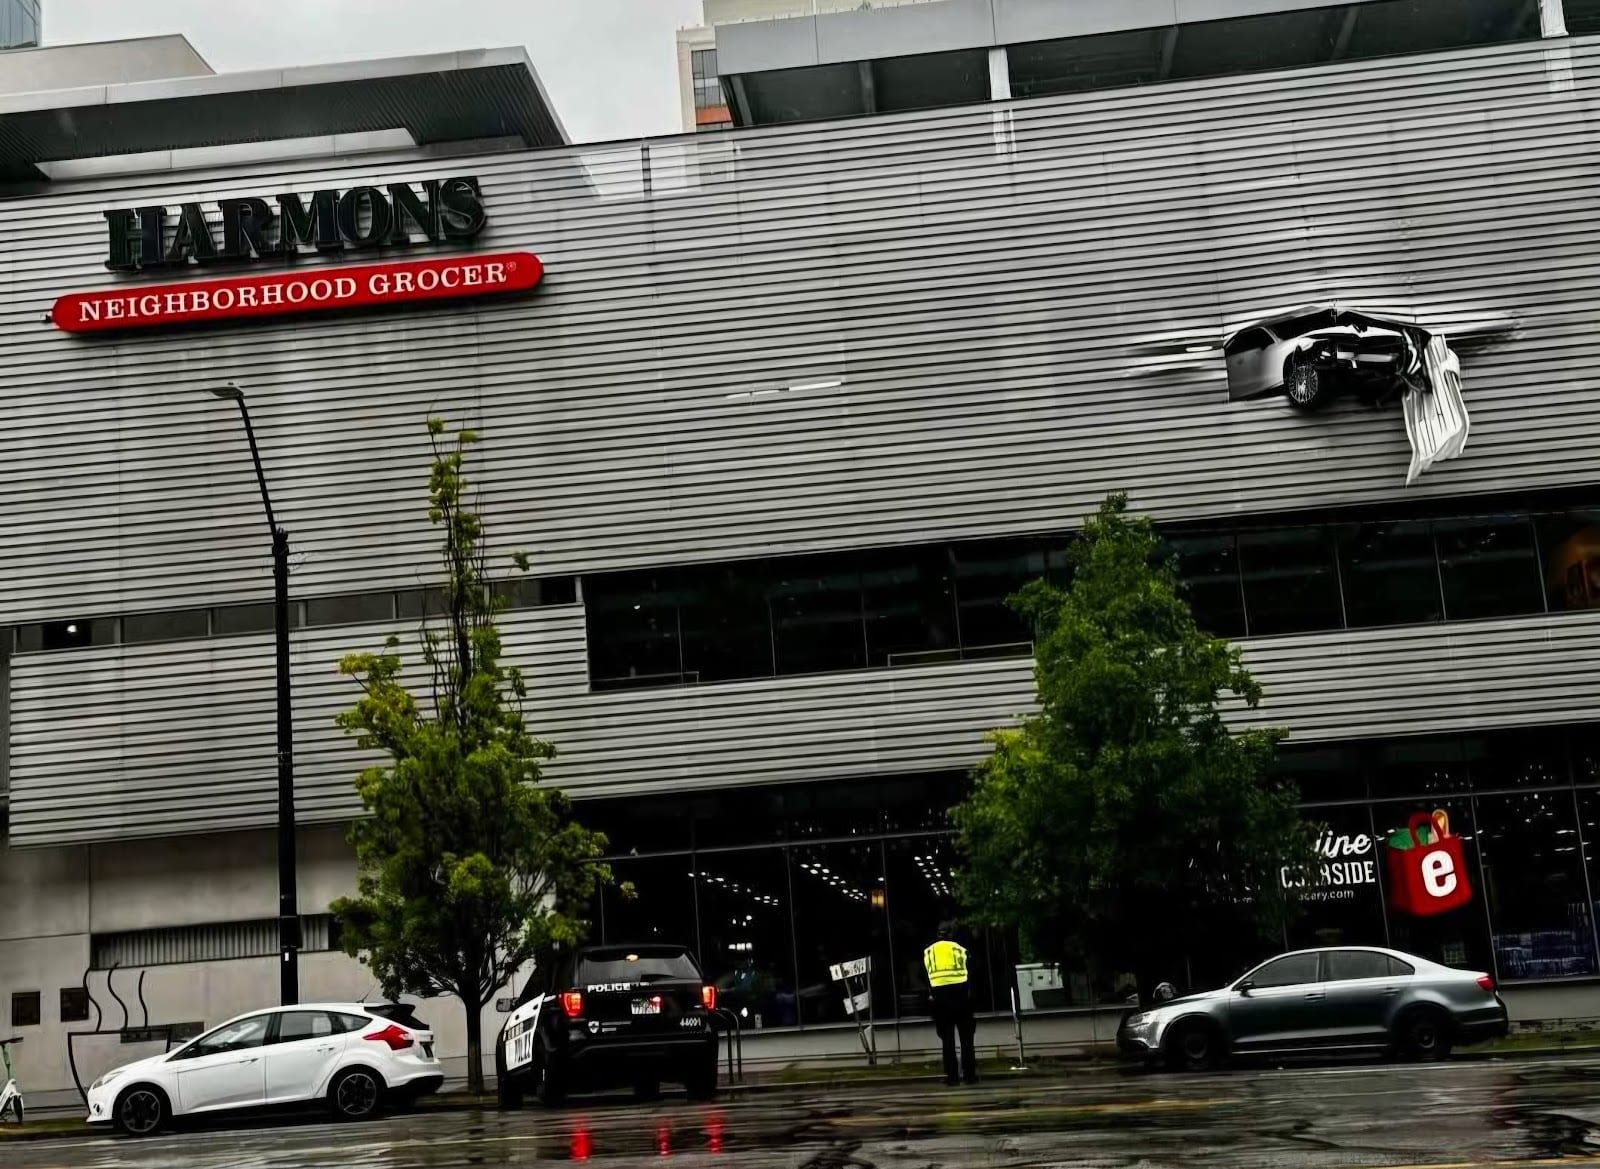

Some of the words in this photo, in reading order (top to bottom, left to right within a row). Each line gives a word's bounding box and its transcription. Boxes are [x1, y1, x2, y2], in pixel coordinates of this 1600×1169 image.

[103, 175, 488, 273] HARMONS
[79, 275, 357, 322] NEIGHBORHOOD
[1280, 861, 1376, 889] CSIDE
[587, 983, 631, 993] POLICE
